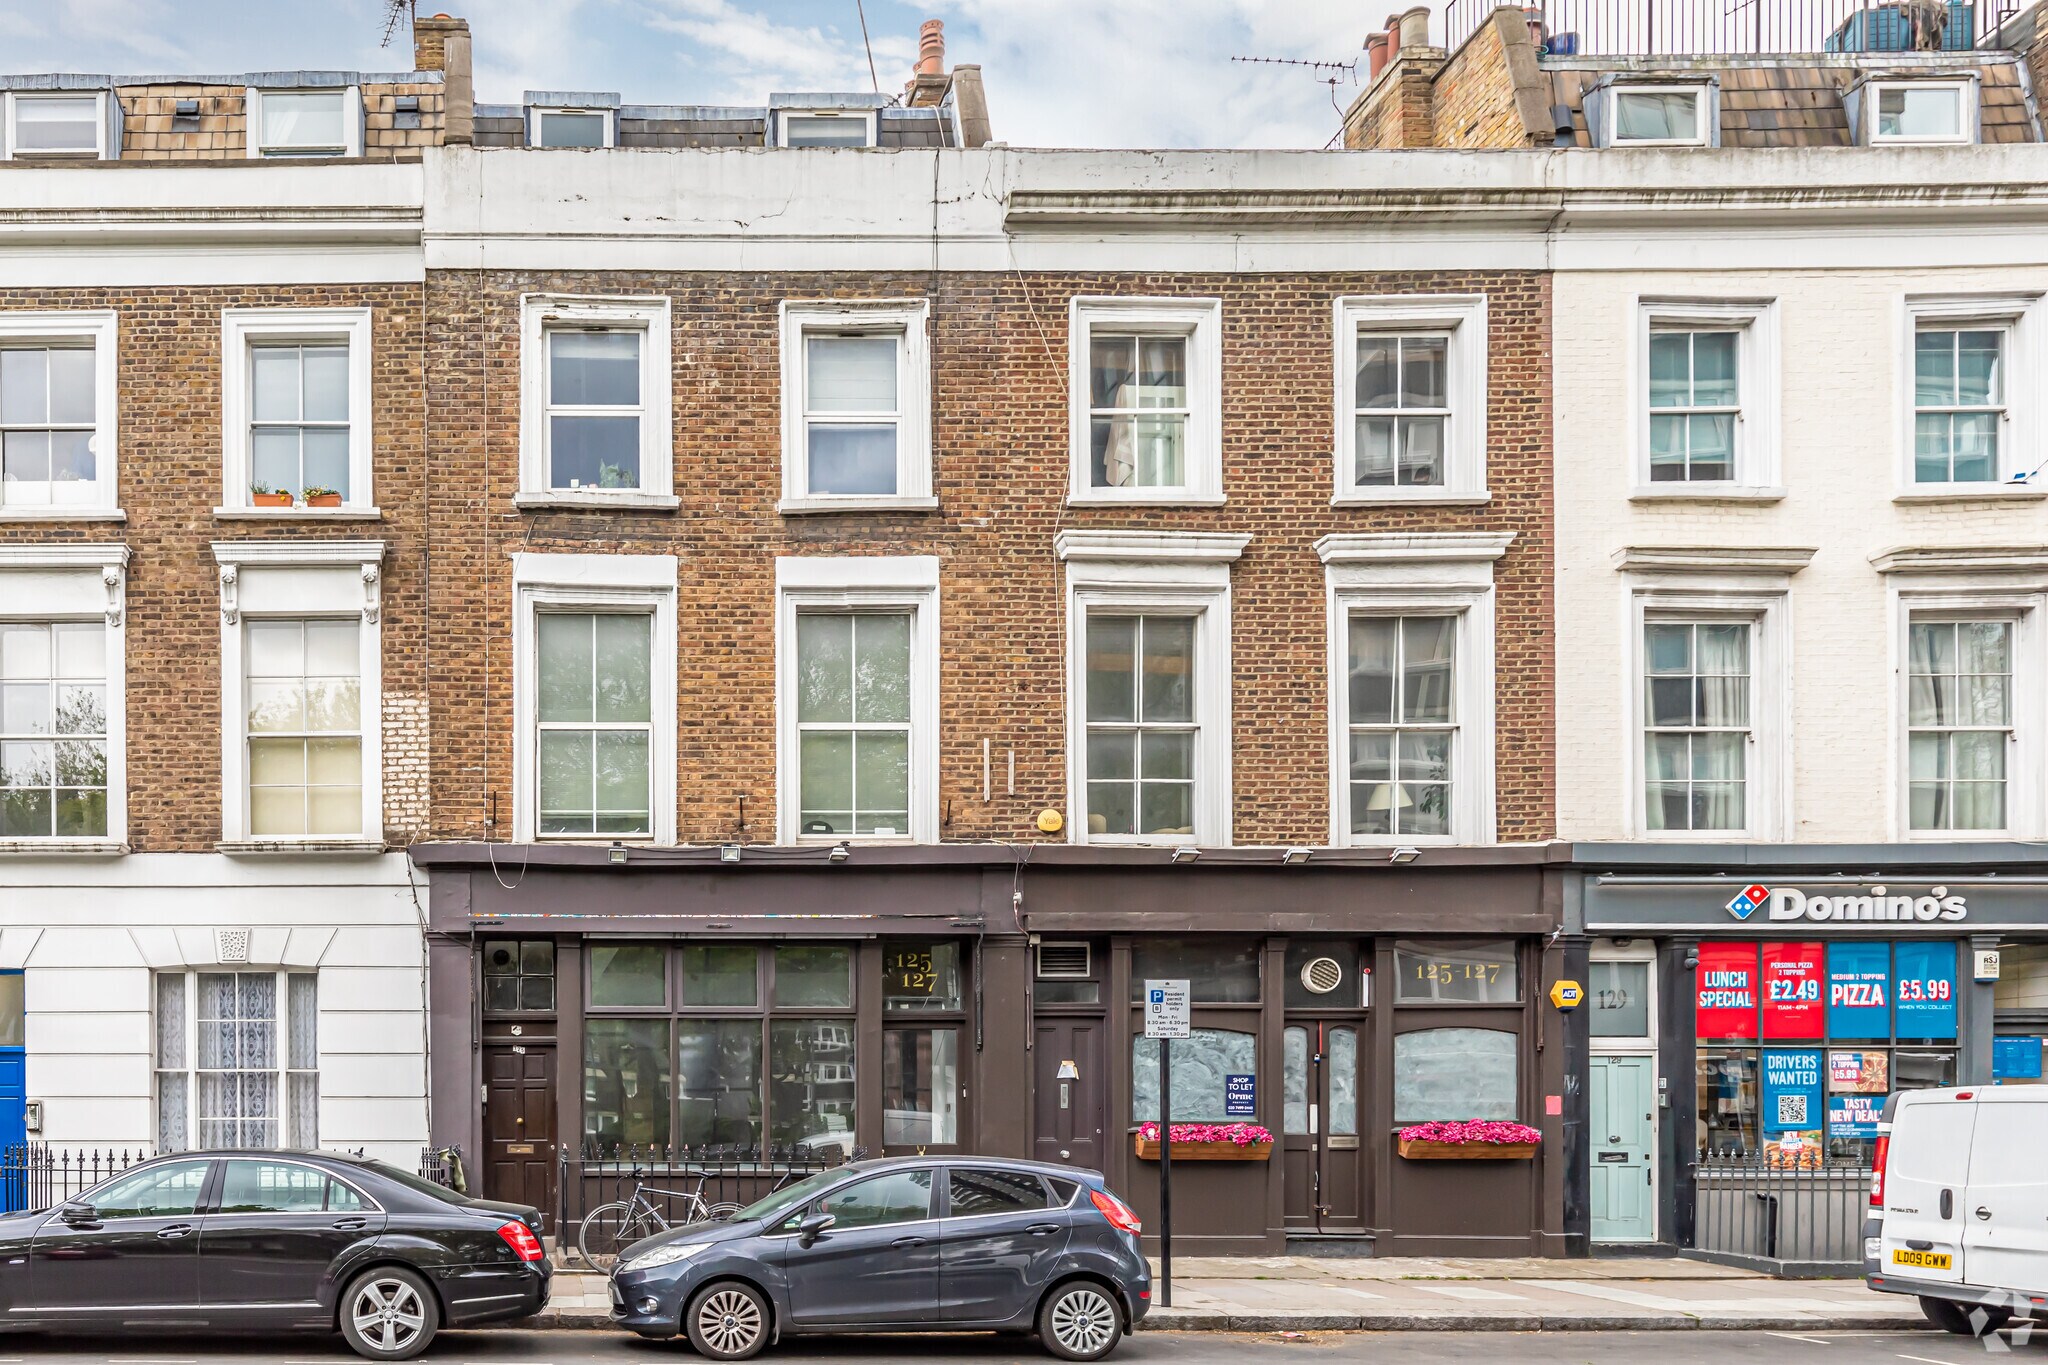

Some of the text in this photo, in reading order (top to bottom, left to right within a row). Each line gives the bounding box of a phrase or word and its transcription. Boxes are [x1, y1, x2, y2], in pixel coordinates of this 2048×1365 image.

[1044, 817, 1060, 825] Yale
[1769, 885, 1967, 921] Domino's
[896, 953, 932, 973] 125
[1984, 956, 1998, 964] RSJ
[902, 973, 938, 993] 127
[1704, 971, 1748, 988] LUNCH
[1770, 979, 1820, 1001] £2.49
[1831, 983, 1886, 1007] PIZZA
[1899, 979, 1950, 1001] £5.99
[1597, 989, 1627, 1009] 129
[1699, 991, 1754, 1008] SPECIAL
[1768, 1055, 1817, 1069] DRIVERS
[1768, 1071, 1817, 1085] WANTED
[1834, 1069, 1857, 1080] £5.99
[1228, 1092, 1253, 1100] Orme
[1843, 1098, 1872, 1110] TASTY
[1829, 1109, 1854, 1122] NEW
[1897, 1251, 1947, 1267] LD09 GWW
